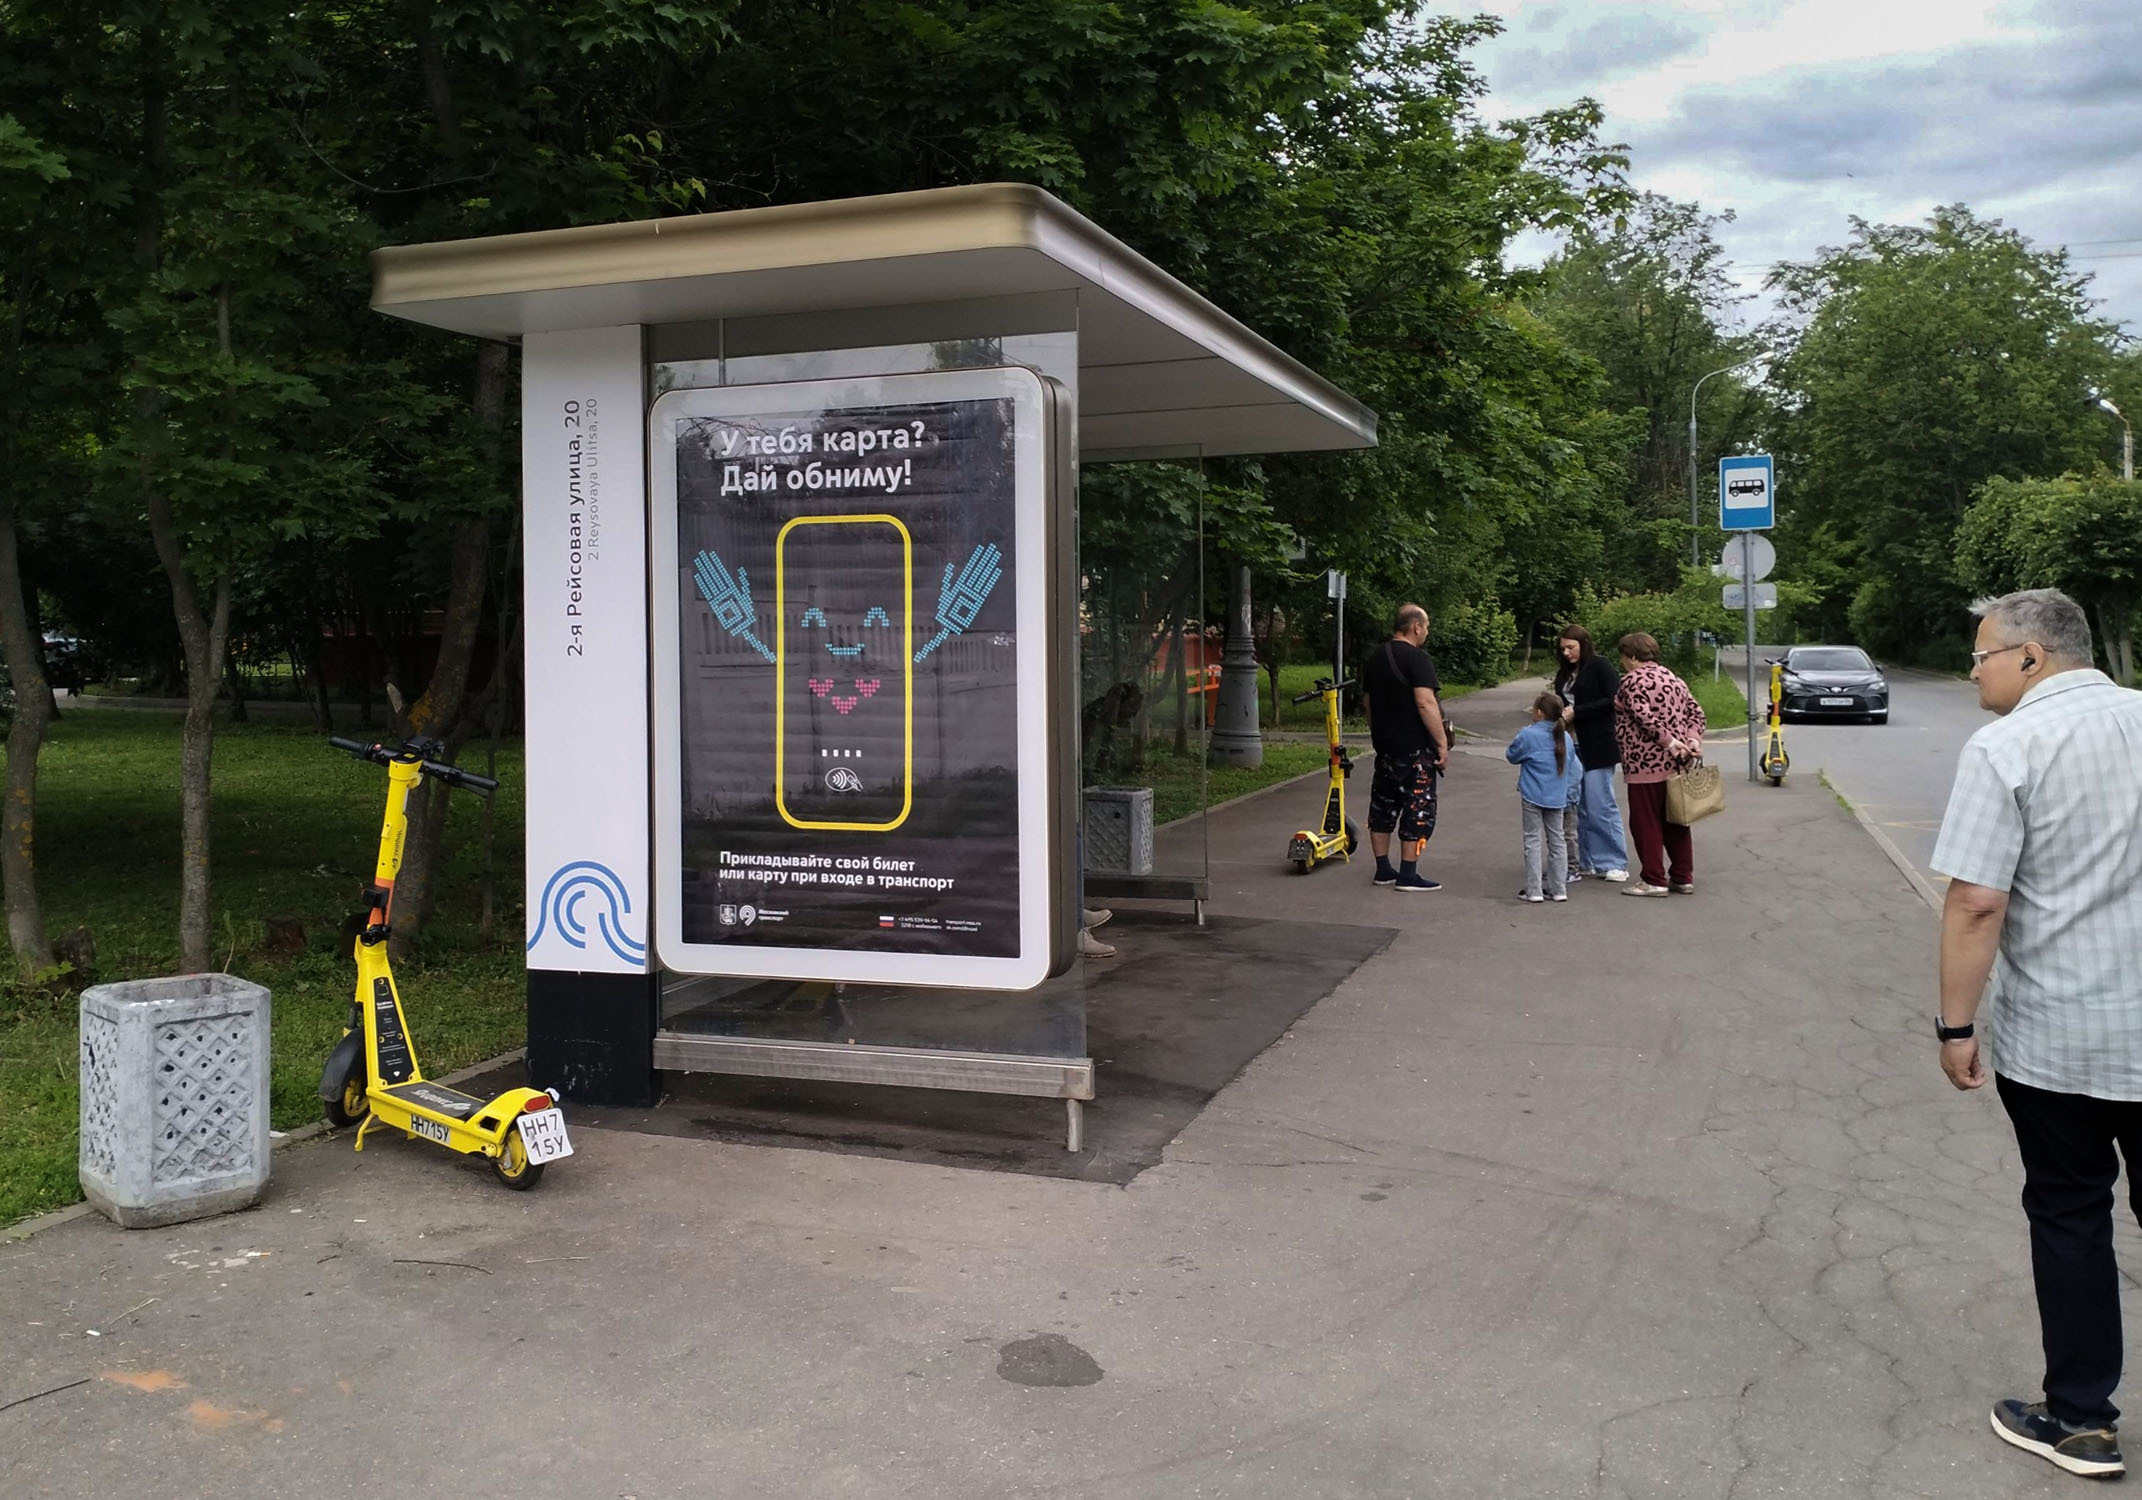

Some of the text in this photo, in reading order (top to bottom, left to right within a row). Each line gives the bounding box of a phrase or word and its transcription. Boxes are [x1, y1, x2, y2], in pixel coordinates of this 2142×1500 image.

[720, 421, 926, 457] У тебя карта?
[586, 398, 601, 562] 2 Reysovaya Ulitsa, 20
[720, 459, 913, 497] Дай обниму!
[564, 399, 585, 657] 2-я Рейсовая улица, 20
[719, 868, 954, 891] или карту при входе в транспорт
[720, 850, 916, 872] Прикладывайте свой билет
